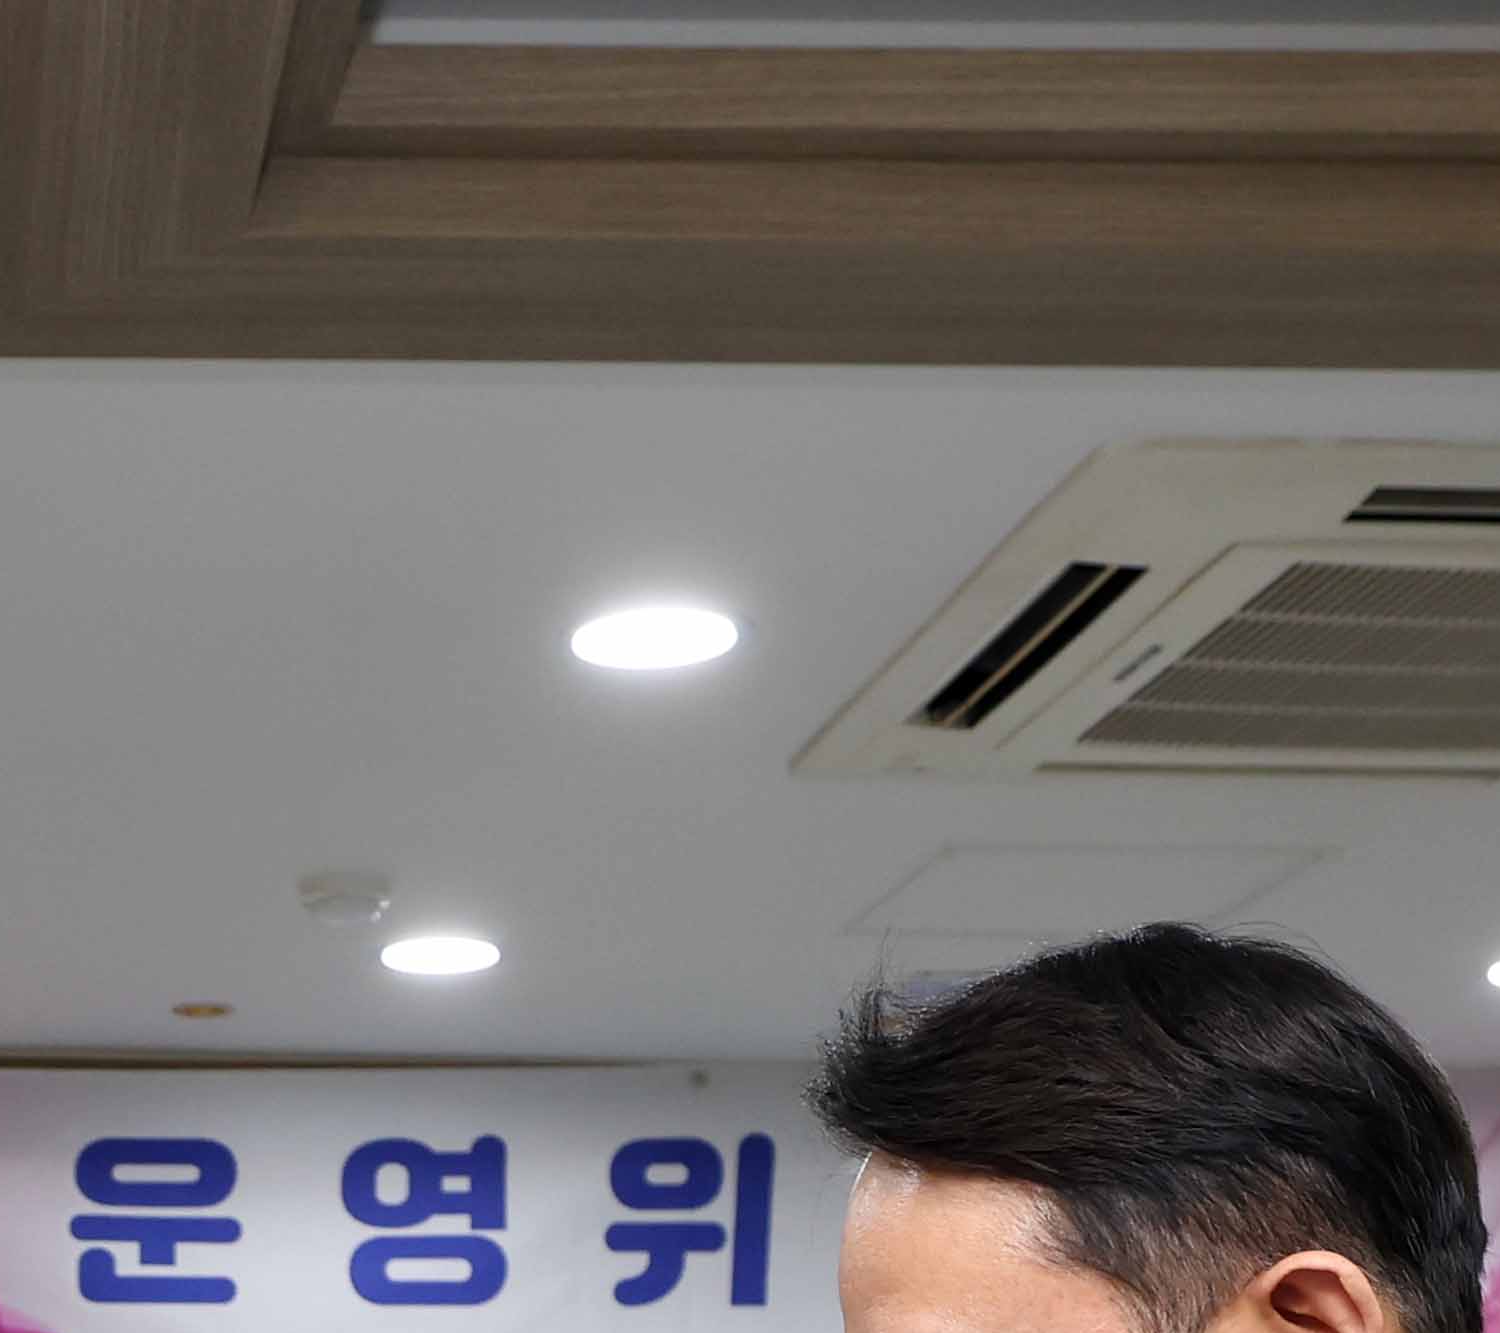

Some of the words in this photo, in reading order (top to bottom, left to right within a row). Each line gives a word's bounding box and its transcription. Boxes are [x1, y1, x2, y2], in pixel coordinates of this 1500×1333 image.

[69, 1137, 243, 1305] 운
[340, 1133, 509, 1307] 영
[604, 1131, 776, 1307] 위
